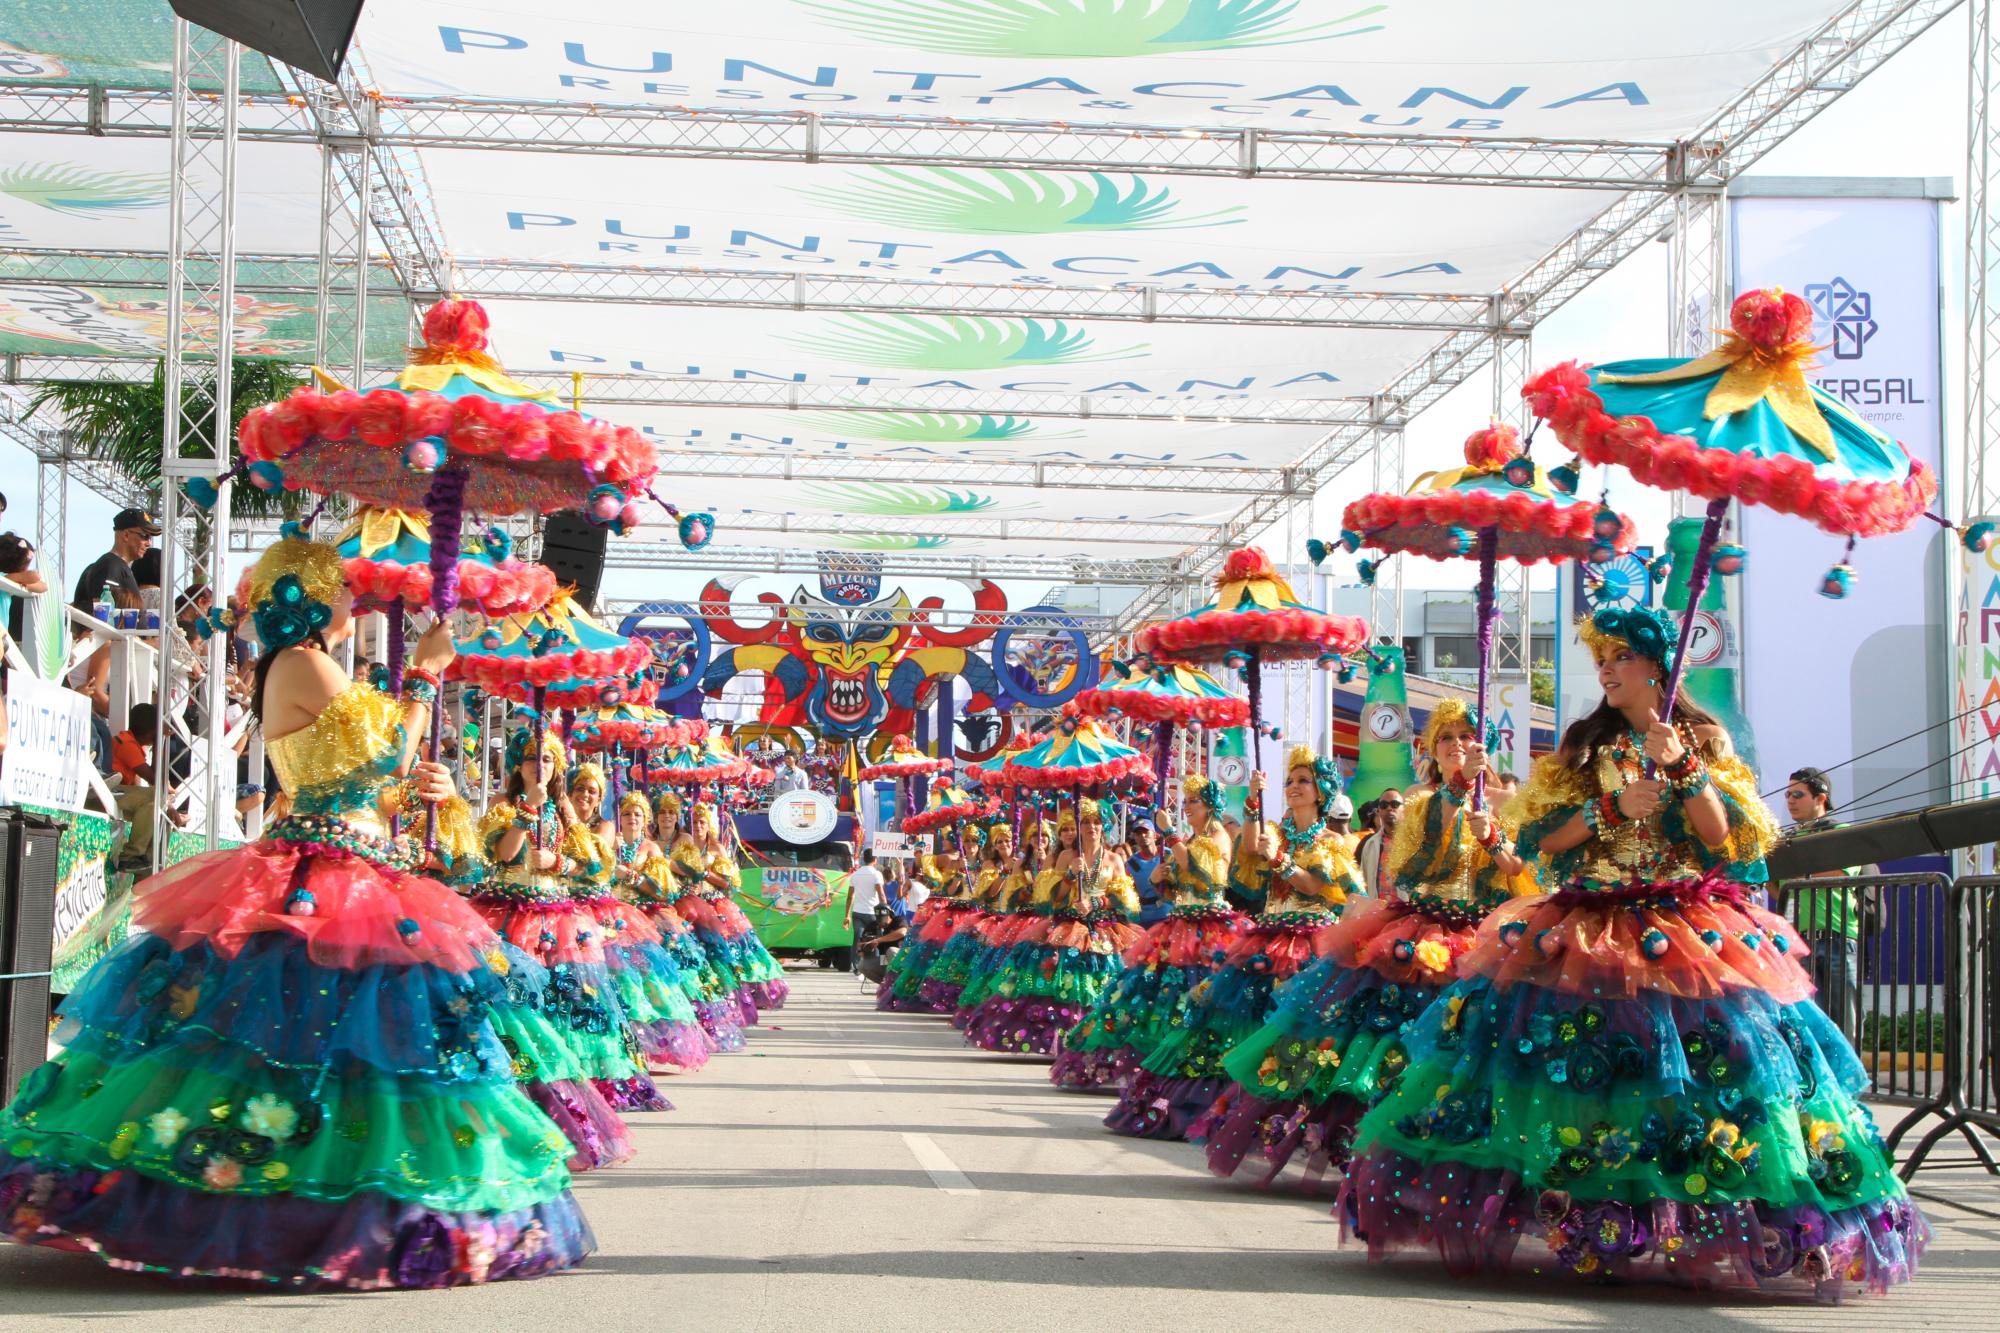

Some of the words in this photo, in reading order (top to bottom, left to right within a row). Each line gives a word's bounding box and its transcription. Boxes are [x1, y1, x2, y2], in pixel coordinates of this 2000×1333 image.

[437, 25, 1650, 110] PUNTACANA
[558, 74, 1012, 104] RESORT
[1210, 104, 1506, 131] CLUB
[506, 211, 1464, 280] PUNTACANA
[598, 241, 961, 275] RESORT
[549, 350, 1342, 393] PUNTACANA
[1816, 378, 1925, 404] ERSAL
[643, 426, 1249, 461] UNTACANA
[838, 583, 868, 598] BRUGAL
